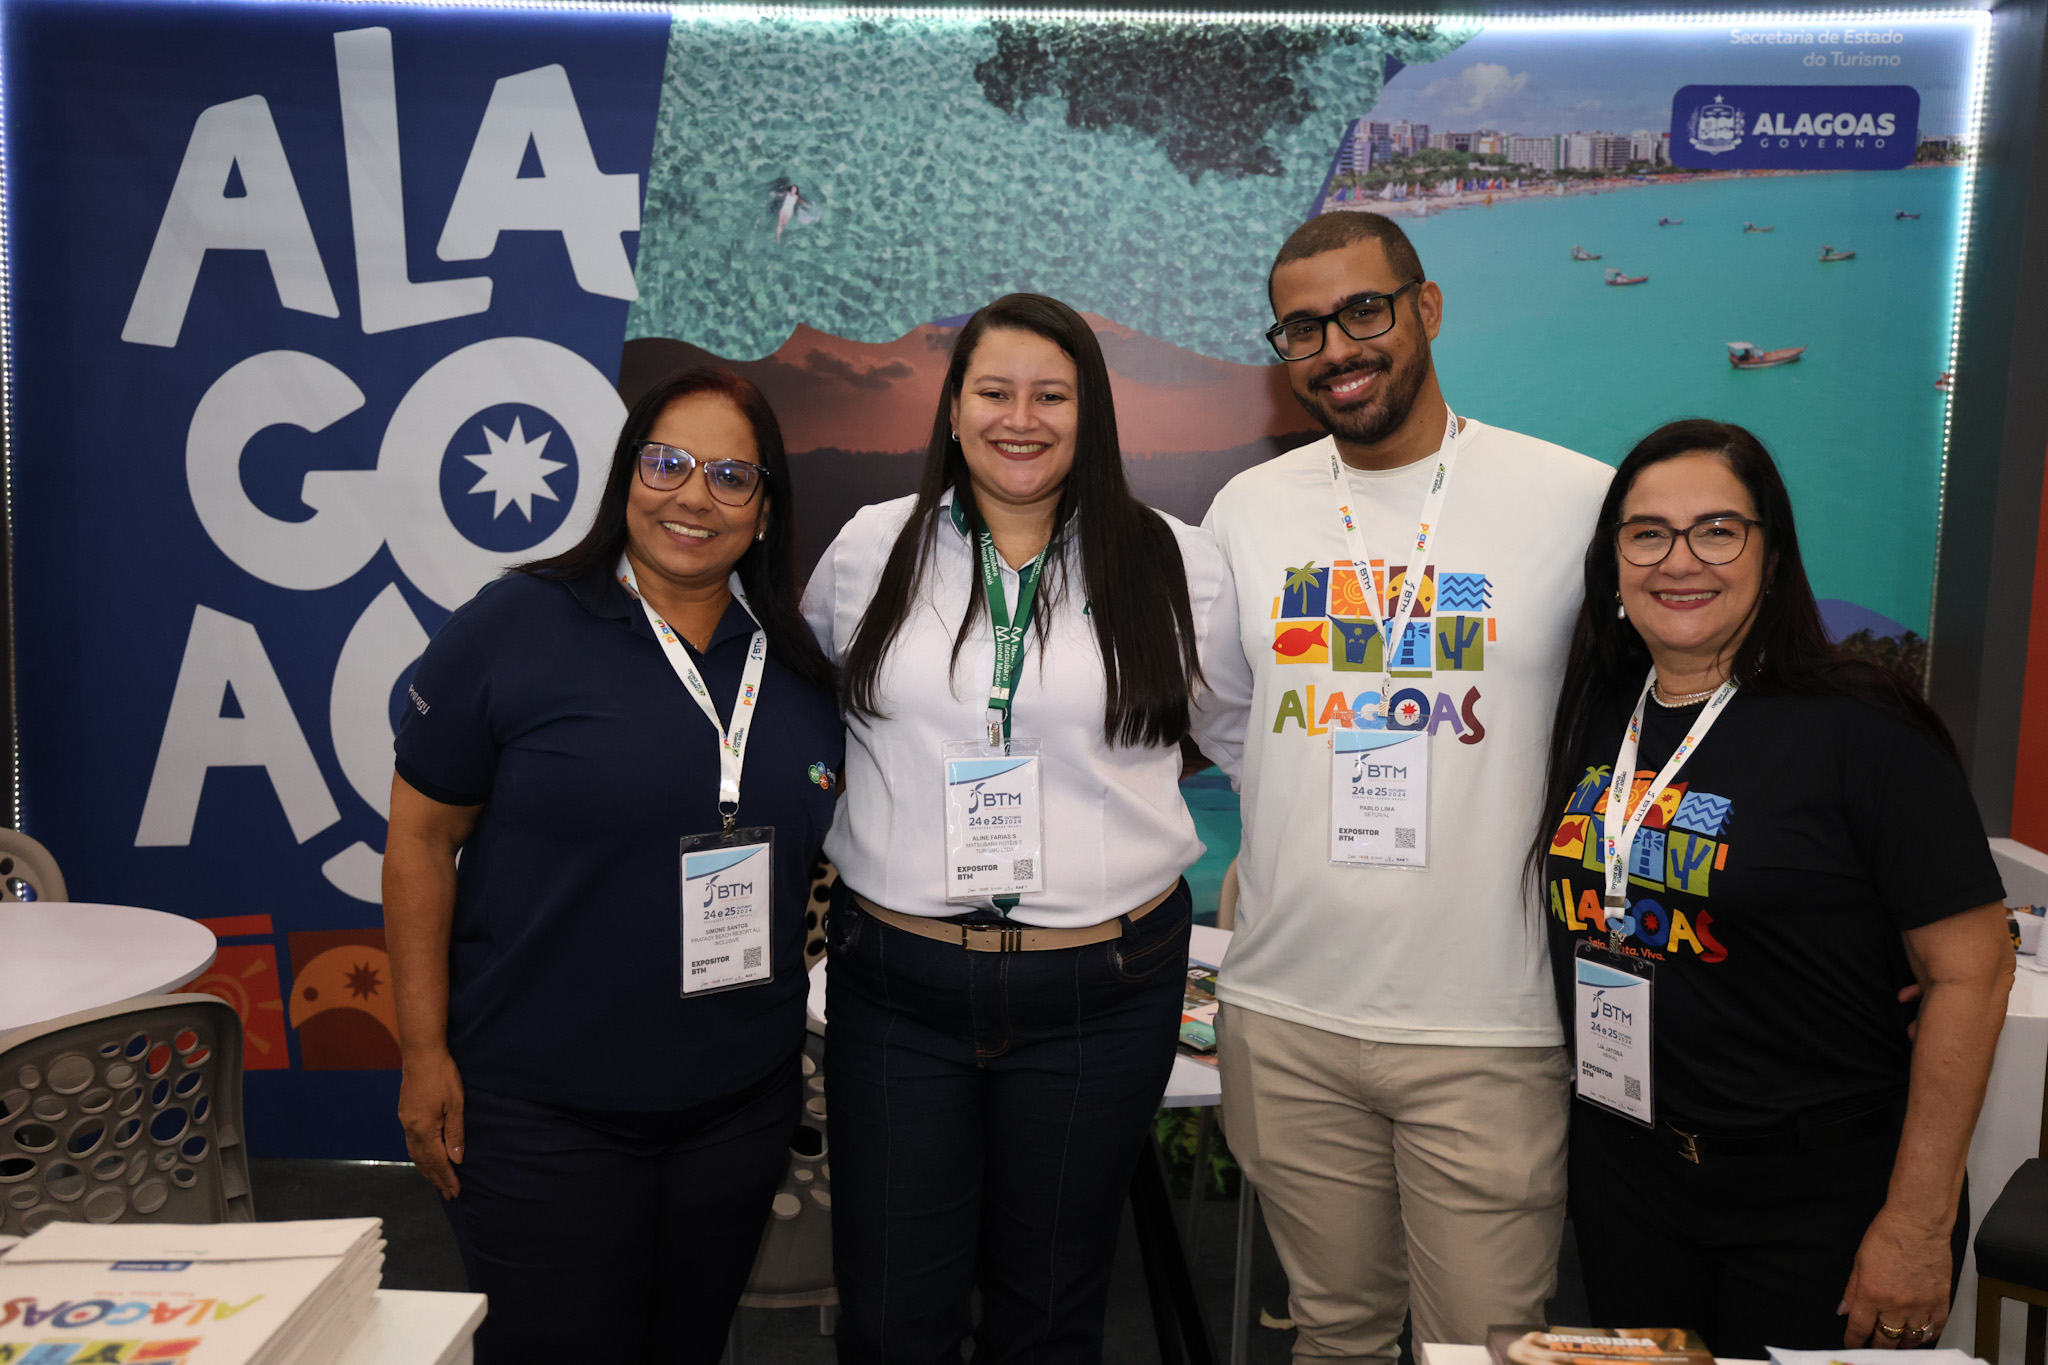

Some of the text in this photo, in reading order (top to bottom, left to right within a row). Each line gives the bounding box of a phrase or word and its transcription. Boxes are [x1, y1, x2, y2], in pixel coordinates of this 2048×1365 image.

[1730, 28, 1904, 45] Secretaria de Estado
[1803, 51, 1902, 67] do Turismo
[1752, 112, 1896, 137] ALAGOAS
[1759, 138, 1886, 149] GOVERNO
[121, 26, 640, 348] ALA
[186, 336, 630, 613] GO
[988, 546, 998, 576] Matsubara
[984, 563, 994, 585] Maceió
[1360, 568, 1371, 590] BTM
[1400, 590, 1413, 612] BTM
[752, 638, 763, 654] BTM
[1272, 685, 1485, 744] ALAGOAS
[1368, 765, 1406, 779] BTM
[984, 792, 1021, 806] BTM
[1352, 786, 1365, 795] 24
[1375, 787, 1387, 796] 25
[1635, 800, 1650, 821] BTM
[969, 817, 982, 826] 24
[992, 816, 1003, 824] 25
[1339, 828, 1379, 836] EXPOSITOR
[718, 882, 752, 899] BTM
[704, 910, 716, 920] 24
[725, 906, 736, 916] 25
[706, 923, 748, 935] SIMONE SANTOS
[715, 937, 739, 946] INCLUSIVE
[692, 956, 730, 967] EXPOSITOR
[1641, 947, 1666, 961] Viva.
[1603, 1002, 1632, 1026] BTM
[1591, 1022, 1601, 1032] 24
[1608, 1028, 1617, 1039] 25
[1582, 1068, 1594, 1078] BTM
[1583, 1061, 1612, 1079] EXPOSITOR
[1545, 1333, 1657, 1346] DESCUBRA
